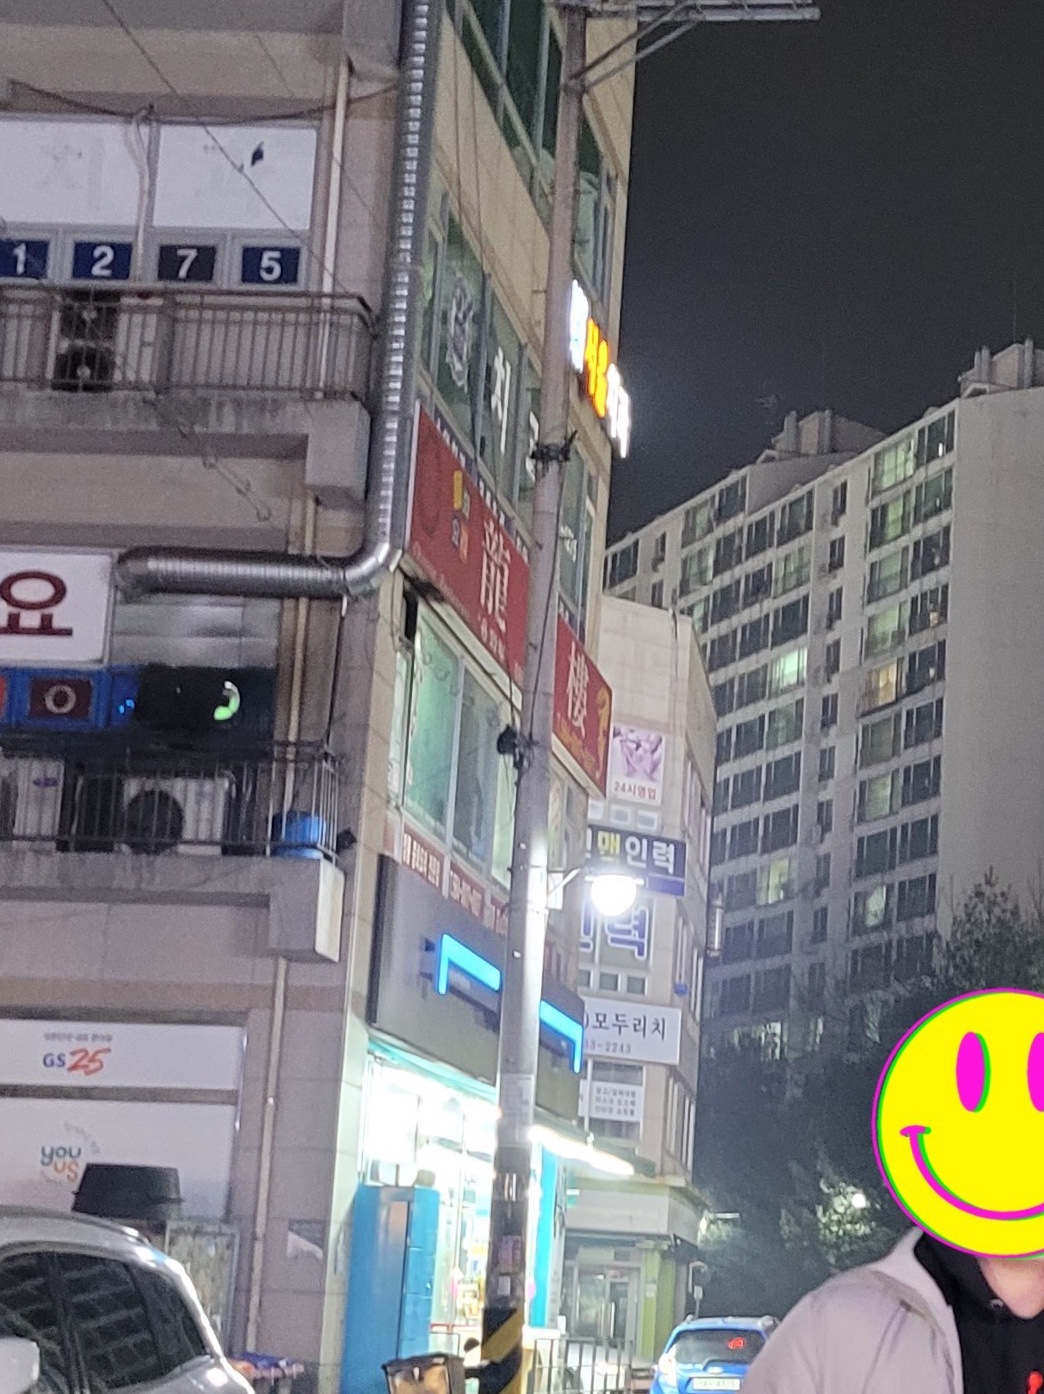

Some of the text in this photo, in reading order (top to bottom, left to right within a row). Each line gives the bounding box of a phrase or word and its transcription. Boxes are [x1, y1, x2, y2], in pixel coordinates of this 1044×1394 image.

[12, 246, 283, 282] 1 2 7 5
[613, 781, 657, 801] 24시영업
[42, 1047, 111, 1076] GS25
[40, 1144, 81, 1167] you
